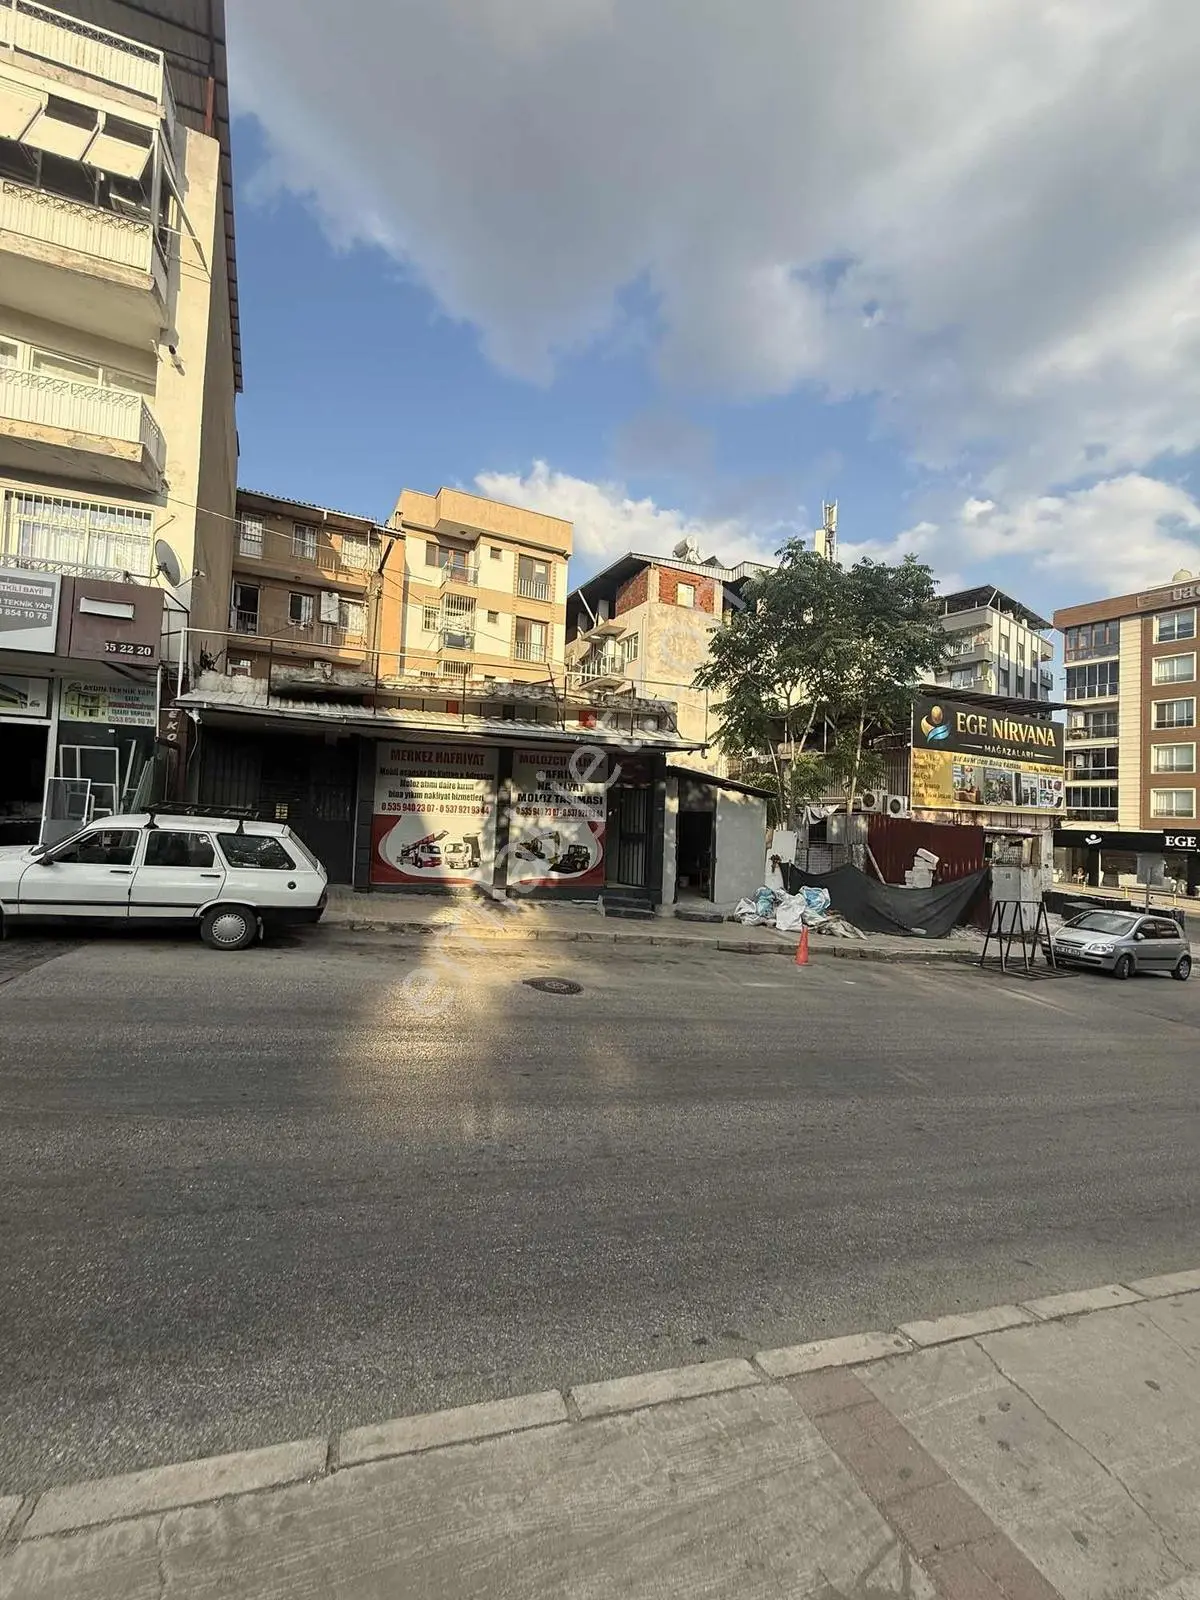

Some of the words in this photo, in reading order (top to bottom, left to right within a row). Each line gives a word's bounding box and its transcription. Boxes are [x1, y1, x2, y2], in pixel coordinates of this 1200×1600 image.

[25, 610, 34, 618] 10
[120, 644, 134, 654] 22
[137, 646, 152, 656] 20
[956, 711, 988, 736] EGE
[390, 748, 433, 763] MERKEZ
[984, 744, 1034, 759] MAĞAZALARI
[517, 793, 553, 803] MOLOZ
[403, 802, 416, 812] 940
[416, 803, 426, 813] 23
[426, 804, 435, 813] 07
[458, 805, 470, 814] 921
[1165, 835, 1197, 848] EGE
